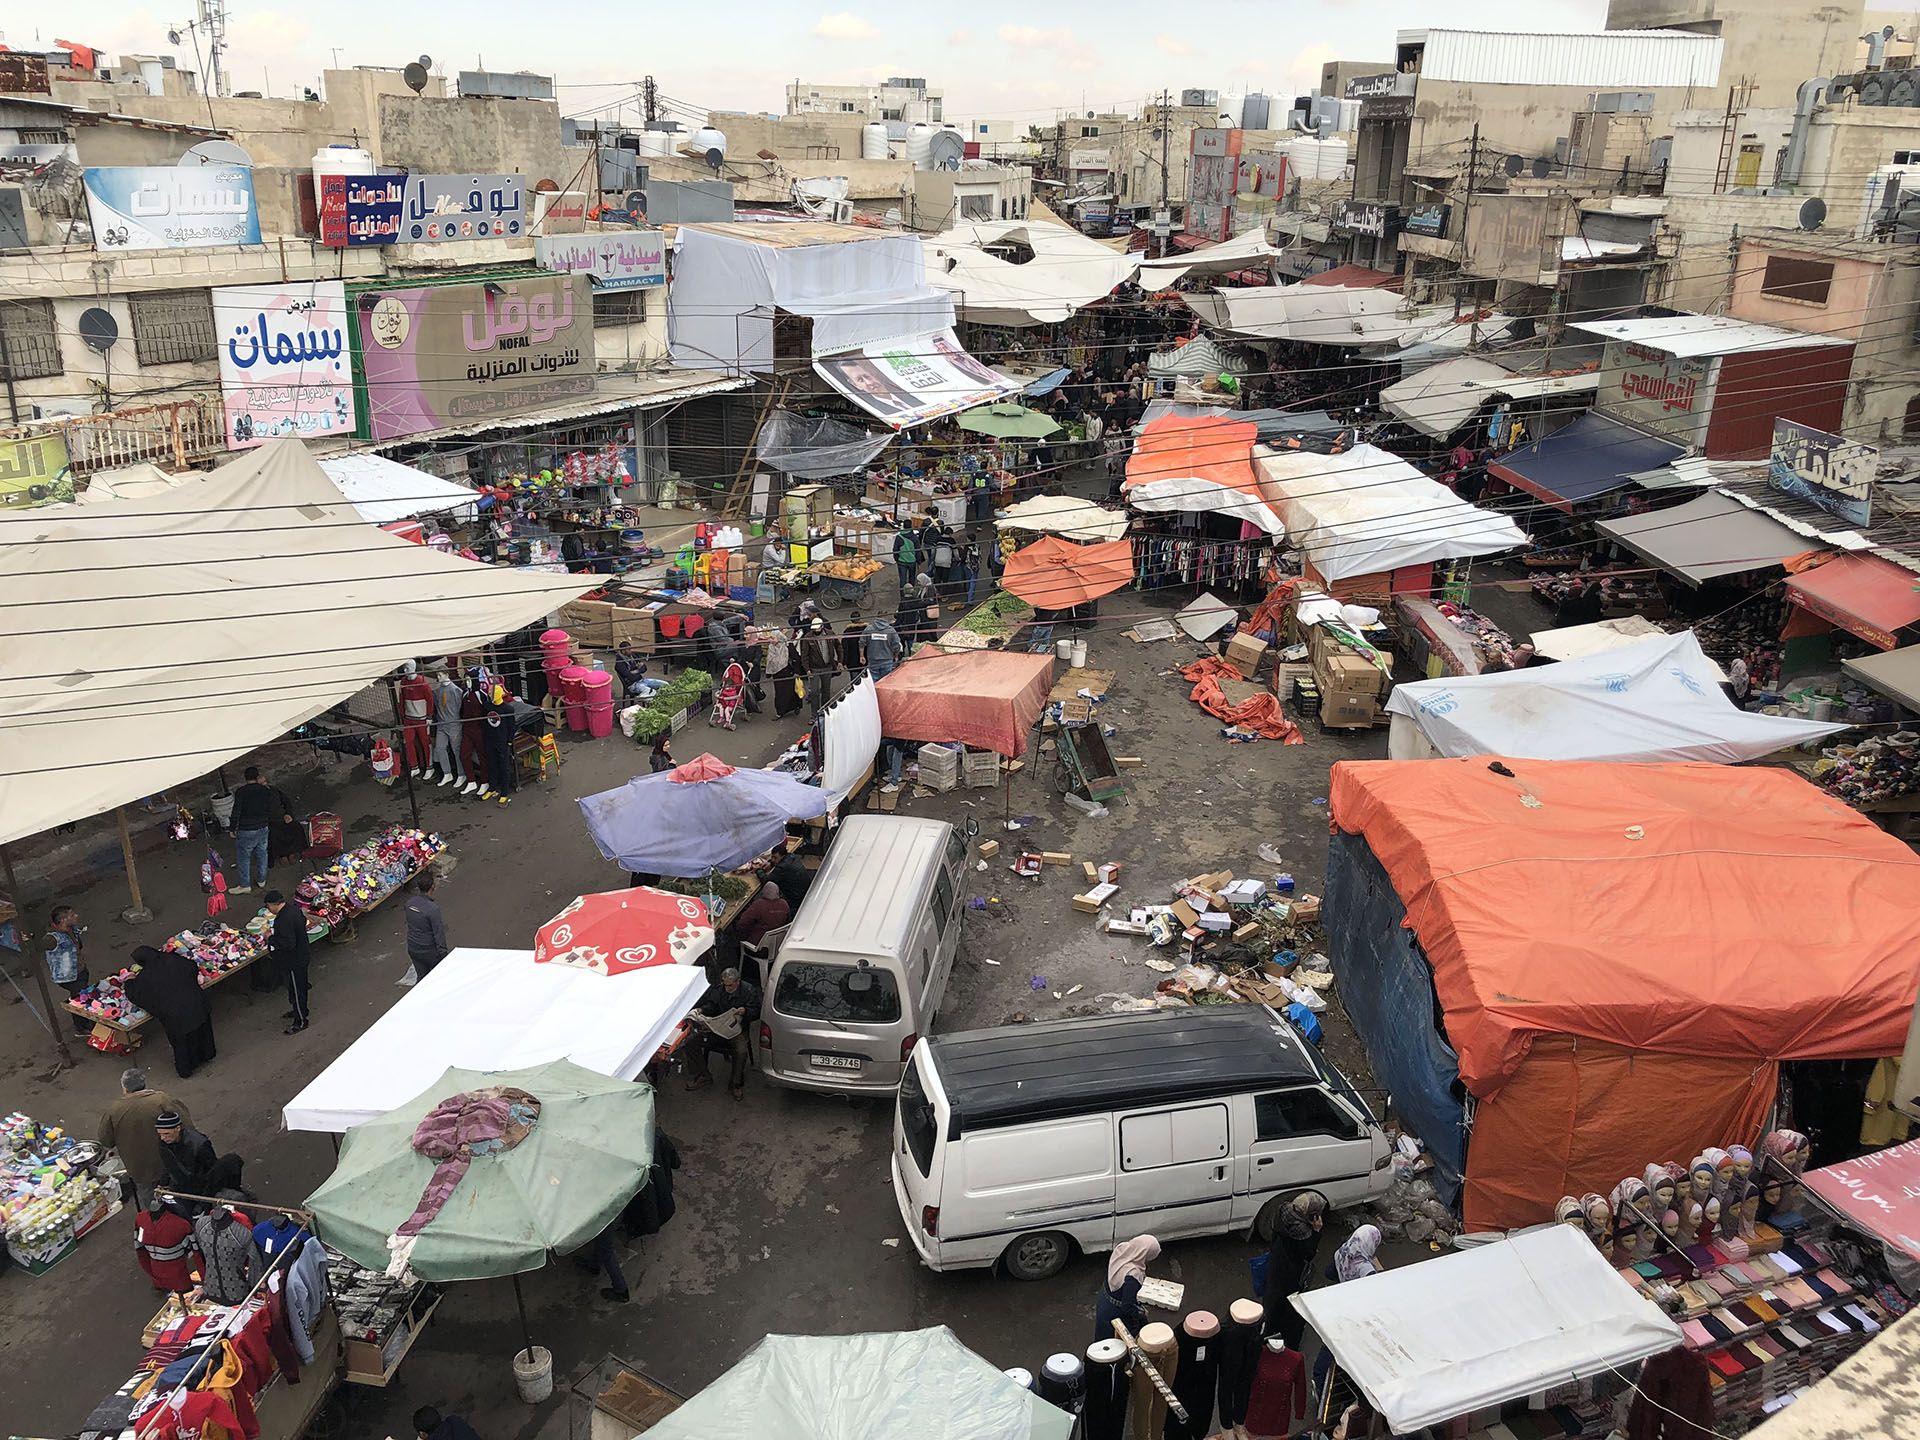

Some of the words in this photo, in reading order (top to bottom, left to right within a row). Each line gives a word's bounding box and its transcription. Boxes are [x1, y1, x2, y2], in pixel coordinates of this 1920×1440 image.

[215, 172, 242, 182] معرض
[131, 183, 249, 223] بسمات
[348, 181, 401, 206] للأدوات
[164, 227, 211, 242] المنزلية
[350, 215, 400, 241] المنزلية
[616, 242, 661, 272] صيدلية
[286, 300, 316, 314] معرض
[462, 281, 574, 352] نوفل
[229, 313, 342, 370] بسمات
[499, 336, 530, 351] NOFAL
[467, 357, 527, 384] المنزلية
[530, 346, 579, 372] للأدوات
[247, 385, 298, 409] المنزلية
[298, 377, 333, 404] للأدوات
